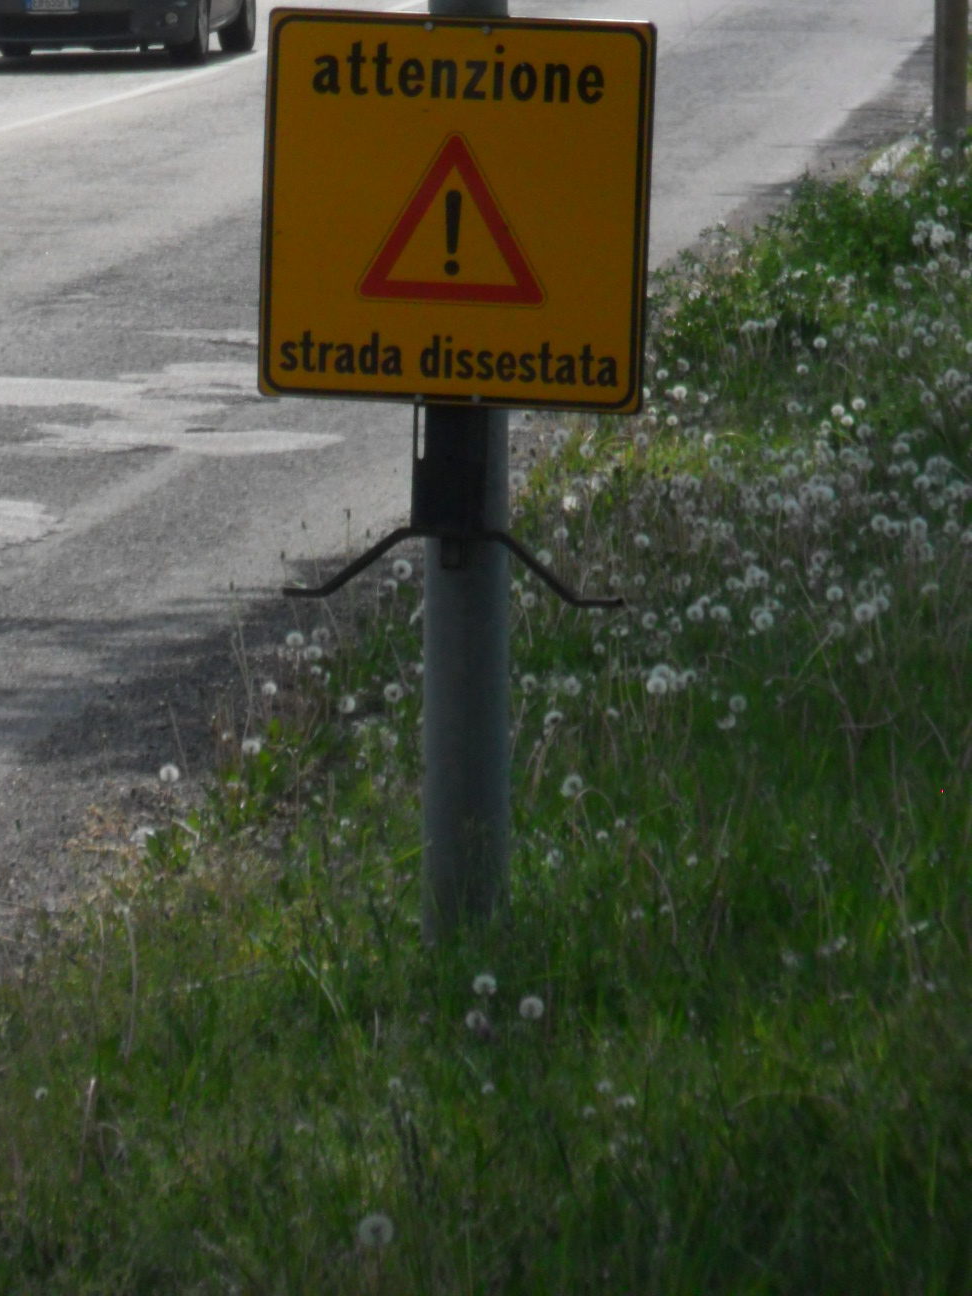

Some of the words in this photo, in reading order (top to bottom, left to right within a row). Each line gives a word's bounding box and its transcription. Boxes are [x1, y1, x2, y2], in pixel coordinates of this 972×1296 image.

[312, 40, 605, 105] attenzione
[280, 330, 402, 377] strada
[419, 334, 618, 388] dissestata
